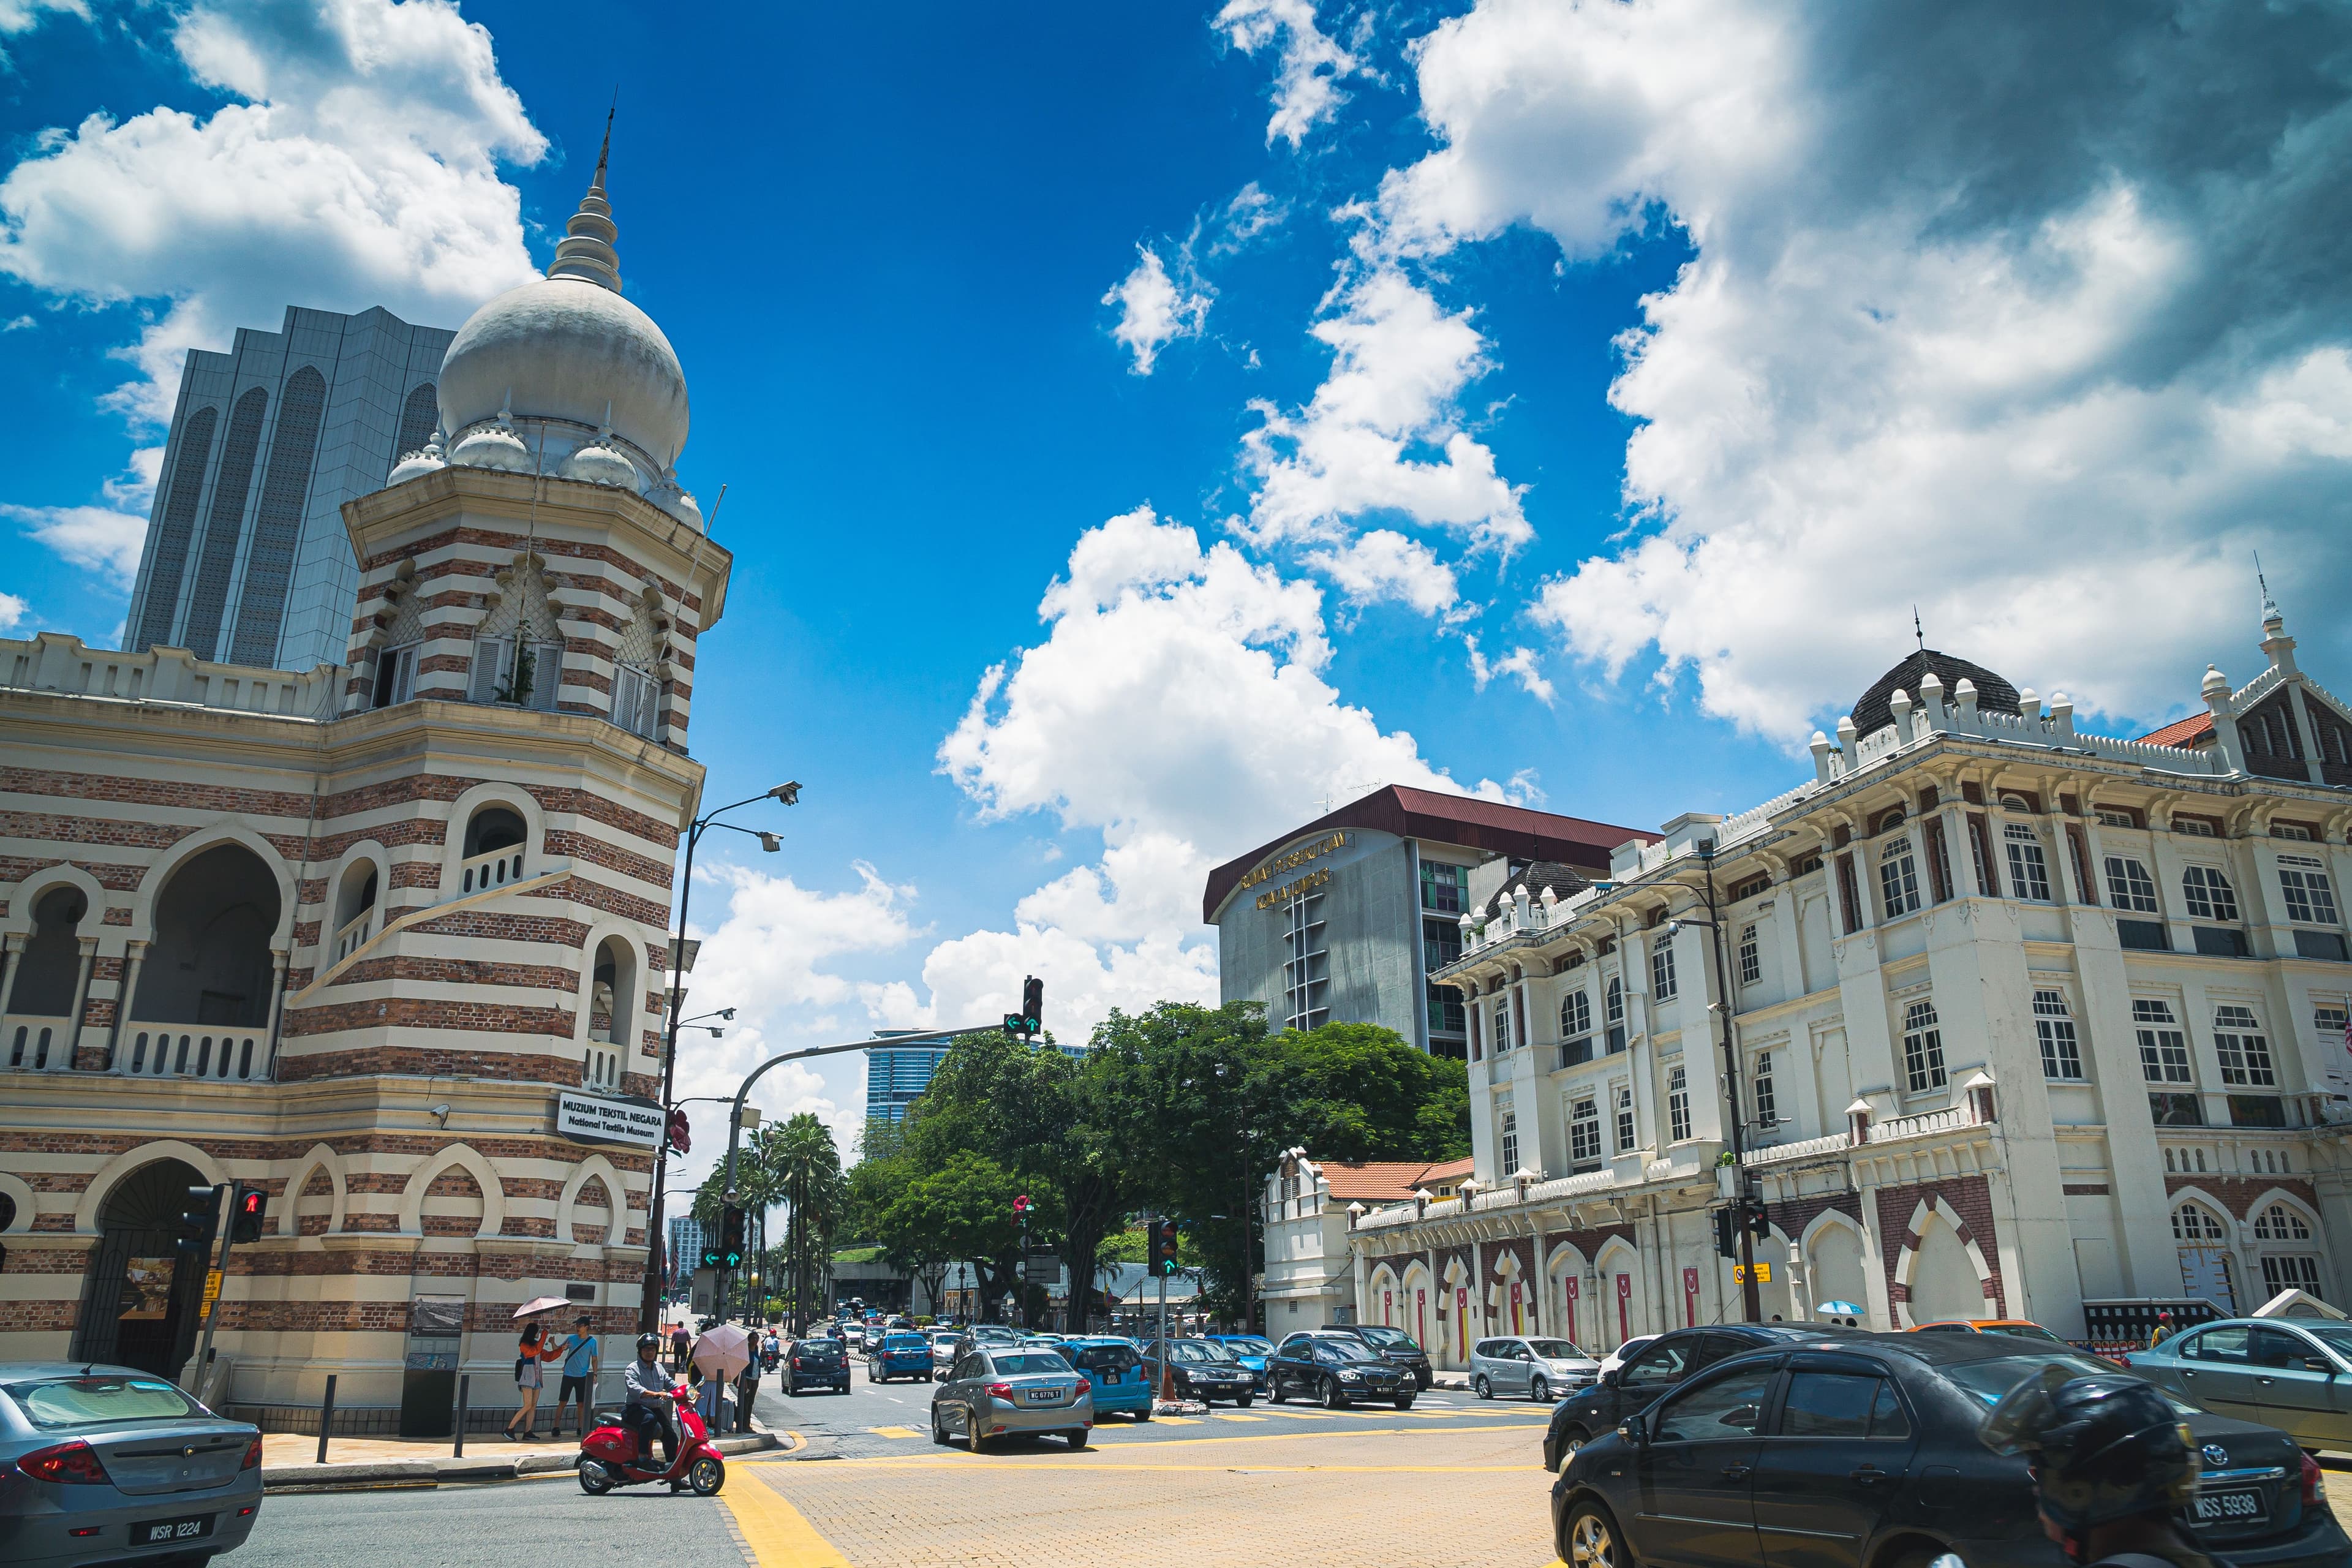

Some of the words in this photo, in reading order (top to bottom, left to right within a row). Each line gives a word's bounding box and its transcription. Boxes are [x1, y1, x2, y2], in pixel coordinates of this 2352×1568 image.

[1241, 862, 1273, 889] RUMAH
[1274, 832, 1346, 875] PERSEKUTUAN
[1256, 885, 1287, 910] KUALA
[1289, 867, 1330, 897] LUMPUR
[562, 1100, 597, 1115] MUZIUM
[598, 1106, 628, 1120] TEKSTIL
[629, 1112, 662, 1127] NEGARA
[568, 1115, 600, 1129] National
[602, 1121, 625, 1133] Textile
[627, 1125, 654, 1138] Museum
[2194, 1497, 2222, 1518] WSS
[2222, 1494, 2258, 1515] 5938
[150, 1525, 173, 1540] WSR
[176, 1520, 201, 1537] 1224
